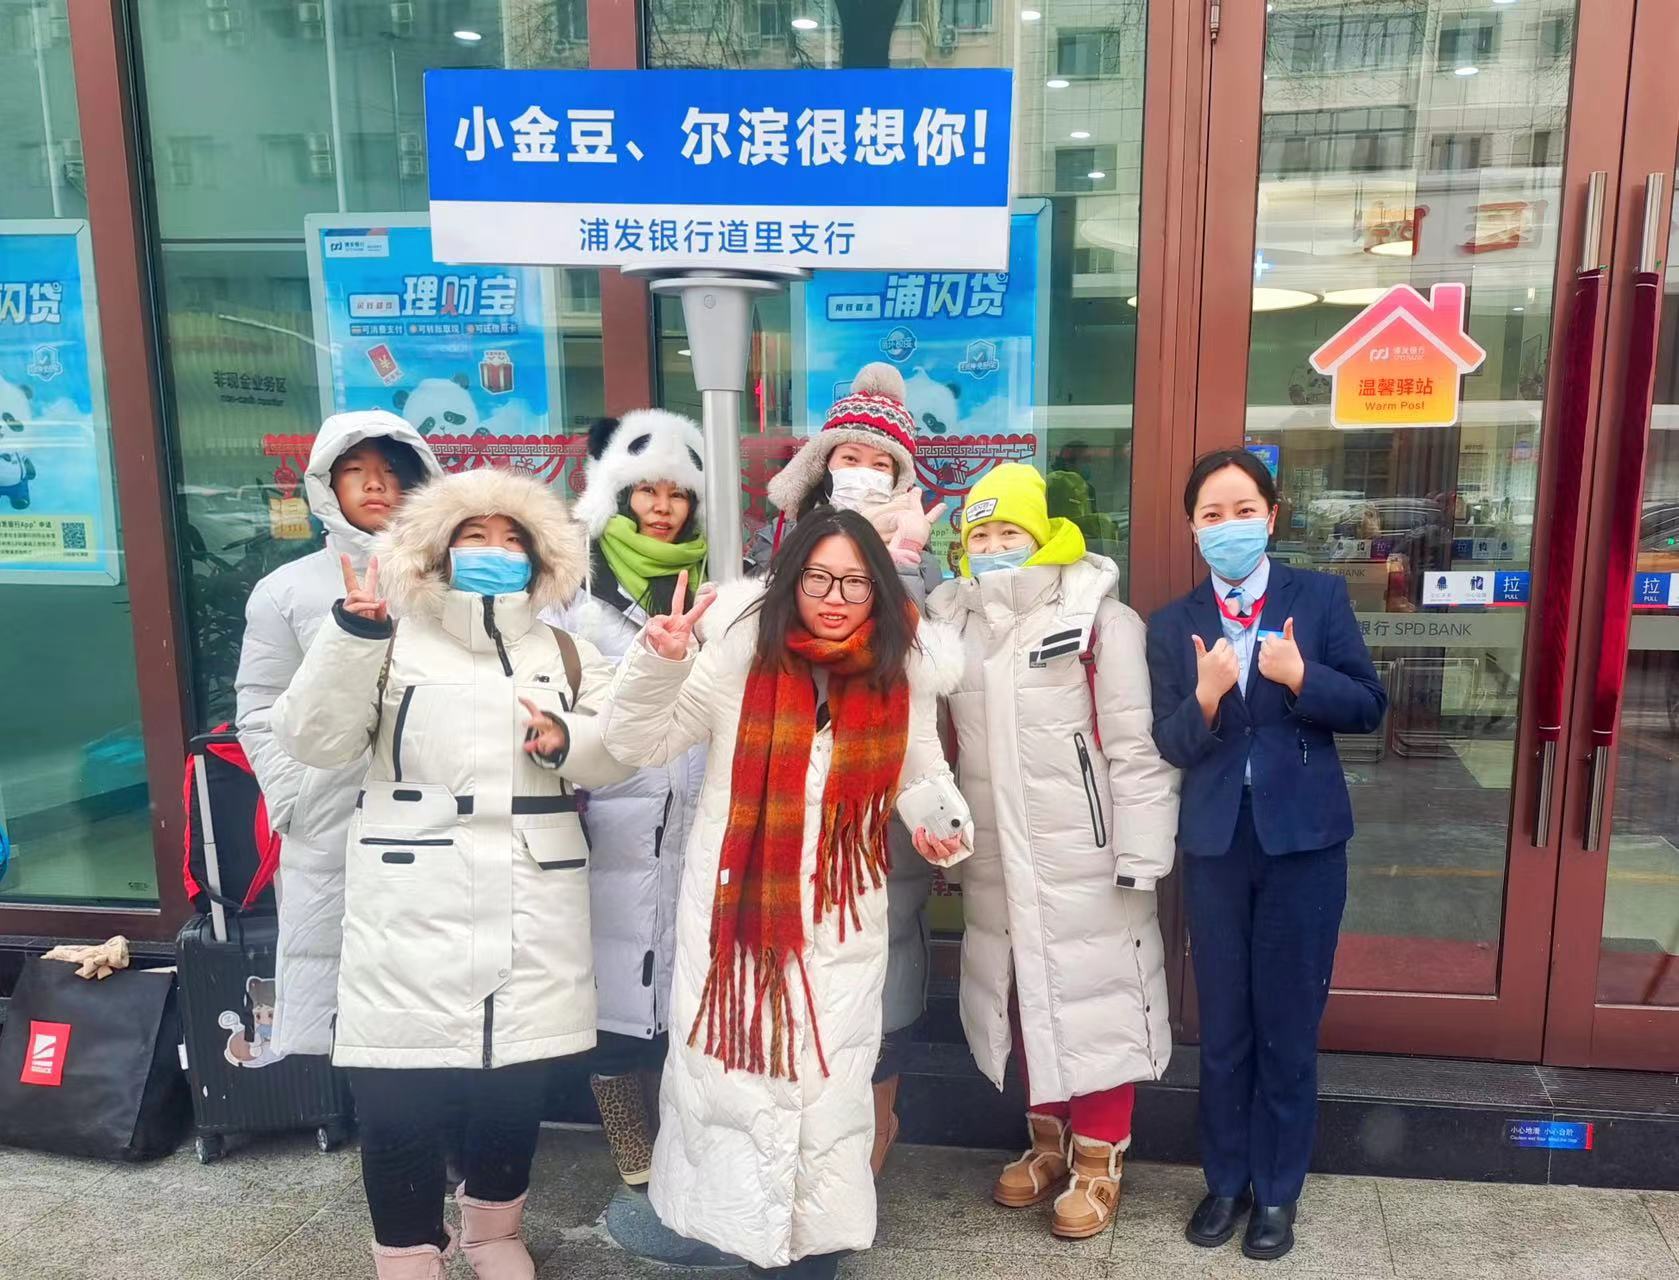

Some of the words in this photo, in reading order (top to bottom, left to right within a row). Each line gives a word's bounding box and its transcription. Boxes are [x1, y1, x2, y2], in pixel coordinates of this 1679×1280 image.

[454, 105, 988, 166] 小金豆、尔滨很想你!
[579, 217, 856, 256] 浦发银行道里支行
[402, 275, 517, 316] 理财宝
[213, 369, 288, 393] 非现金业务区
[1358, 377, 1434, 396] 温馨驿站
[1365, 401, 1397, 411] Warm
[1400, 400, 1425, 410] Post
[1503, 576, 1520, 592] 拉
[1642, 577, 1660, 594] 拉
[1394, 621, 1426, 636] SPD
[1428, 622, 1473, 637] BANK
[1510, 1126, 1540, 1135] 小心地滑
